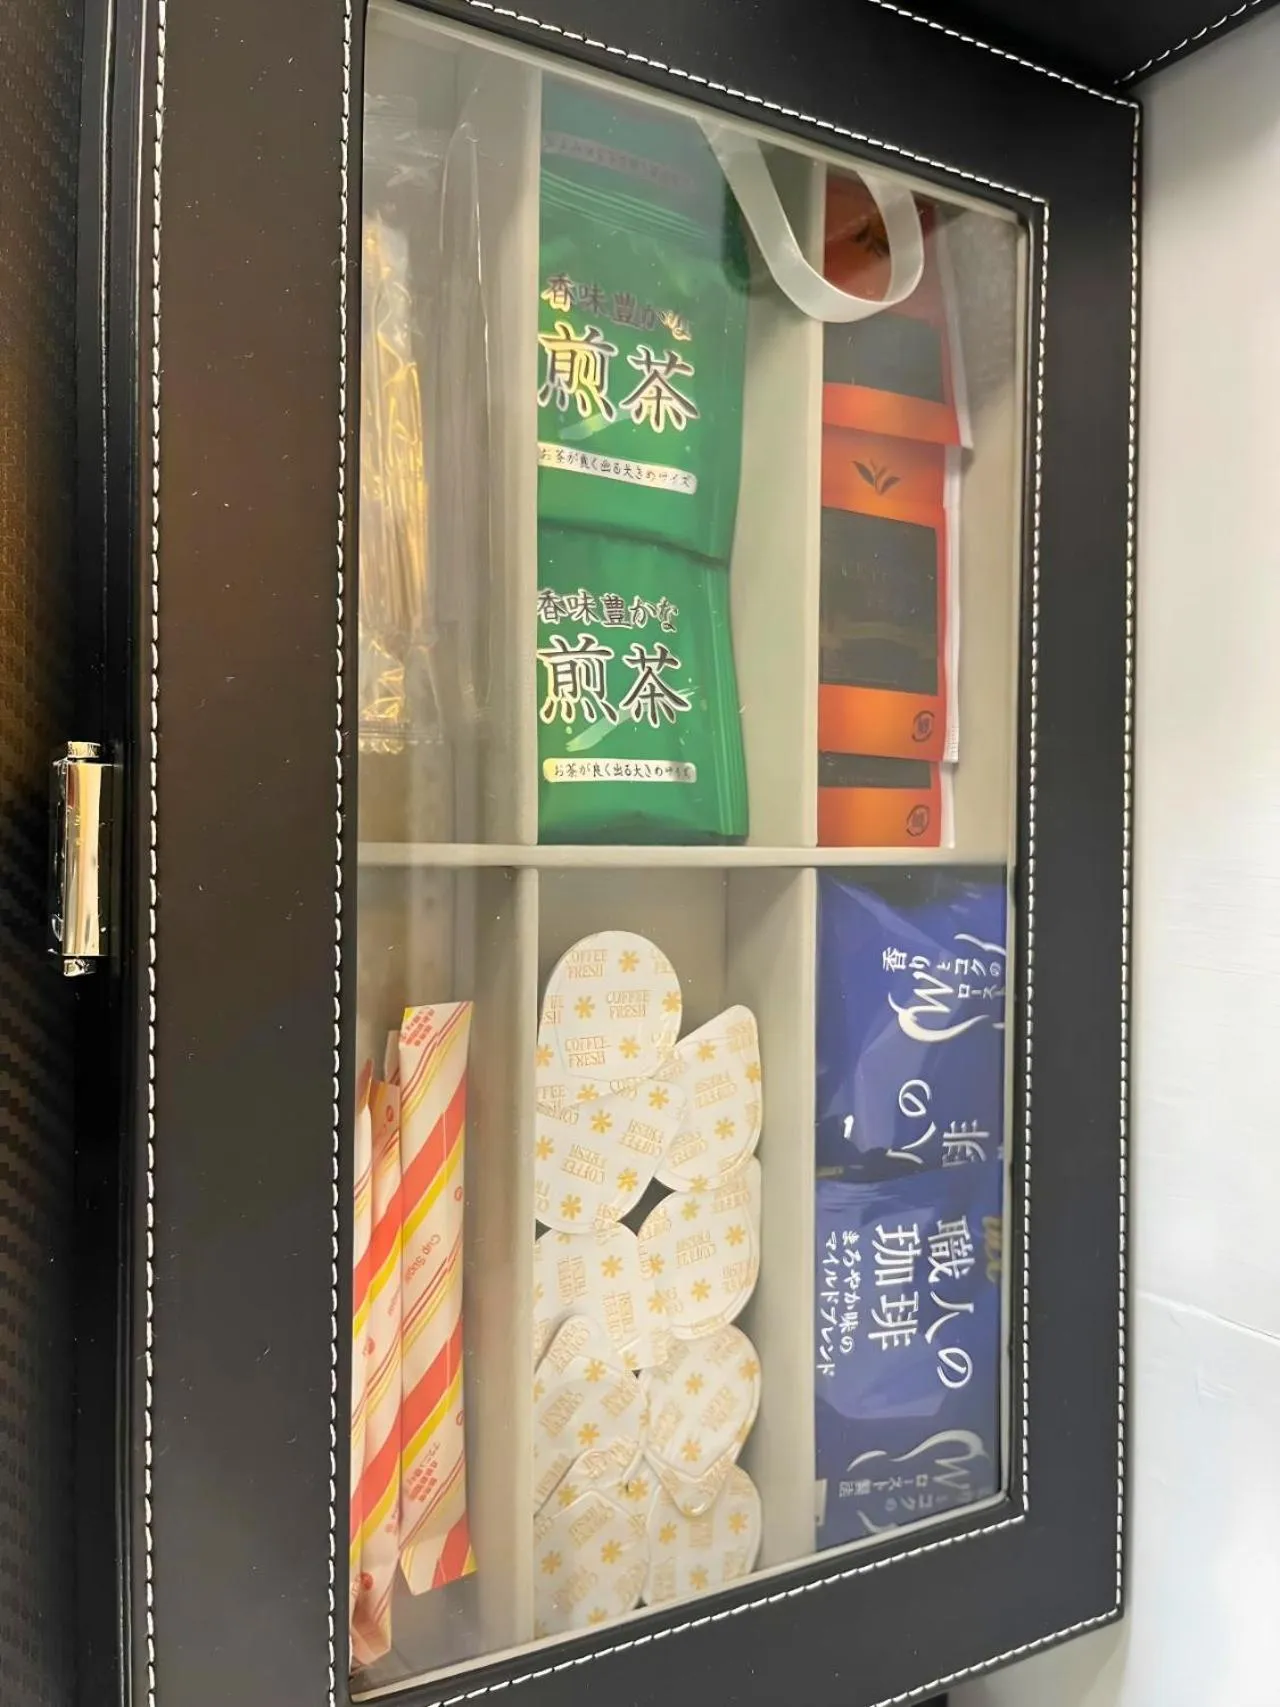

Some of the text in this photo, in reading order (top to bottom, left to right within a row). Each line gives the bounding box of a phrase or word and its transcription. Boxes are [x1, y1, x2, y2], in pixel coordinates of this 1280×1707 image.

[541, 273, 692, 341] 香味豊かな
[537, 321, 699, 433] 煎茶
[538, 588, 679, 632] 香味豊かな
[537, 633, 692, 727] 煎茶
[816, 1231, 841, 1378] マイルドブレンド
[839, 1230, 862, 1353] まろやか味の
[867, 1222, 923, 1351] 珈琲
[923, 1215, 975, 1389] 職人の
